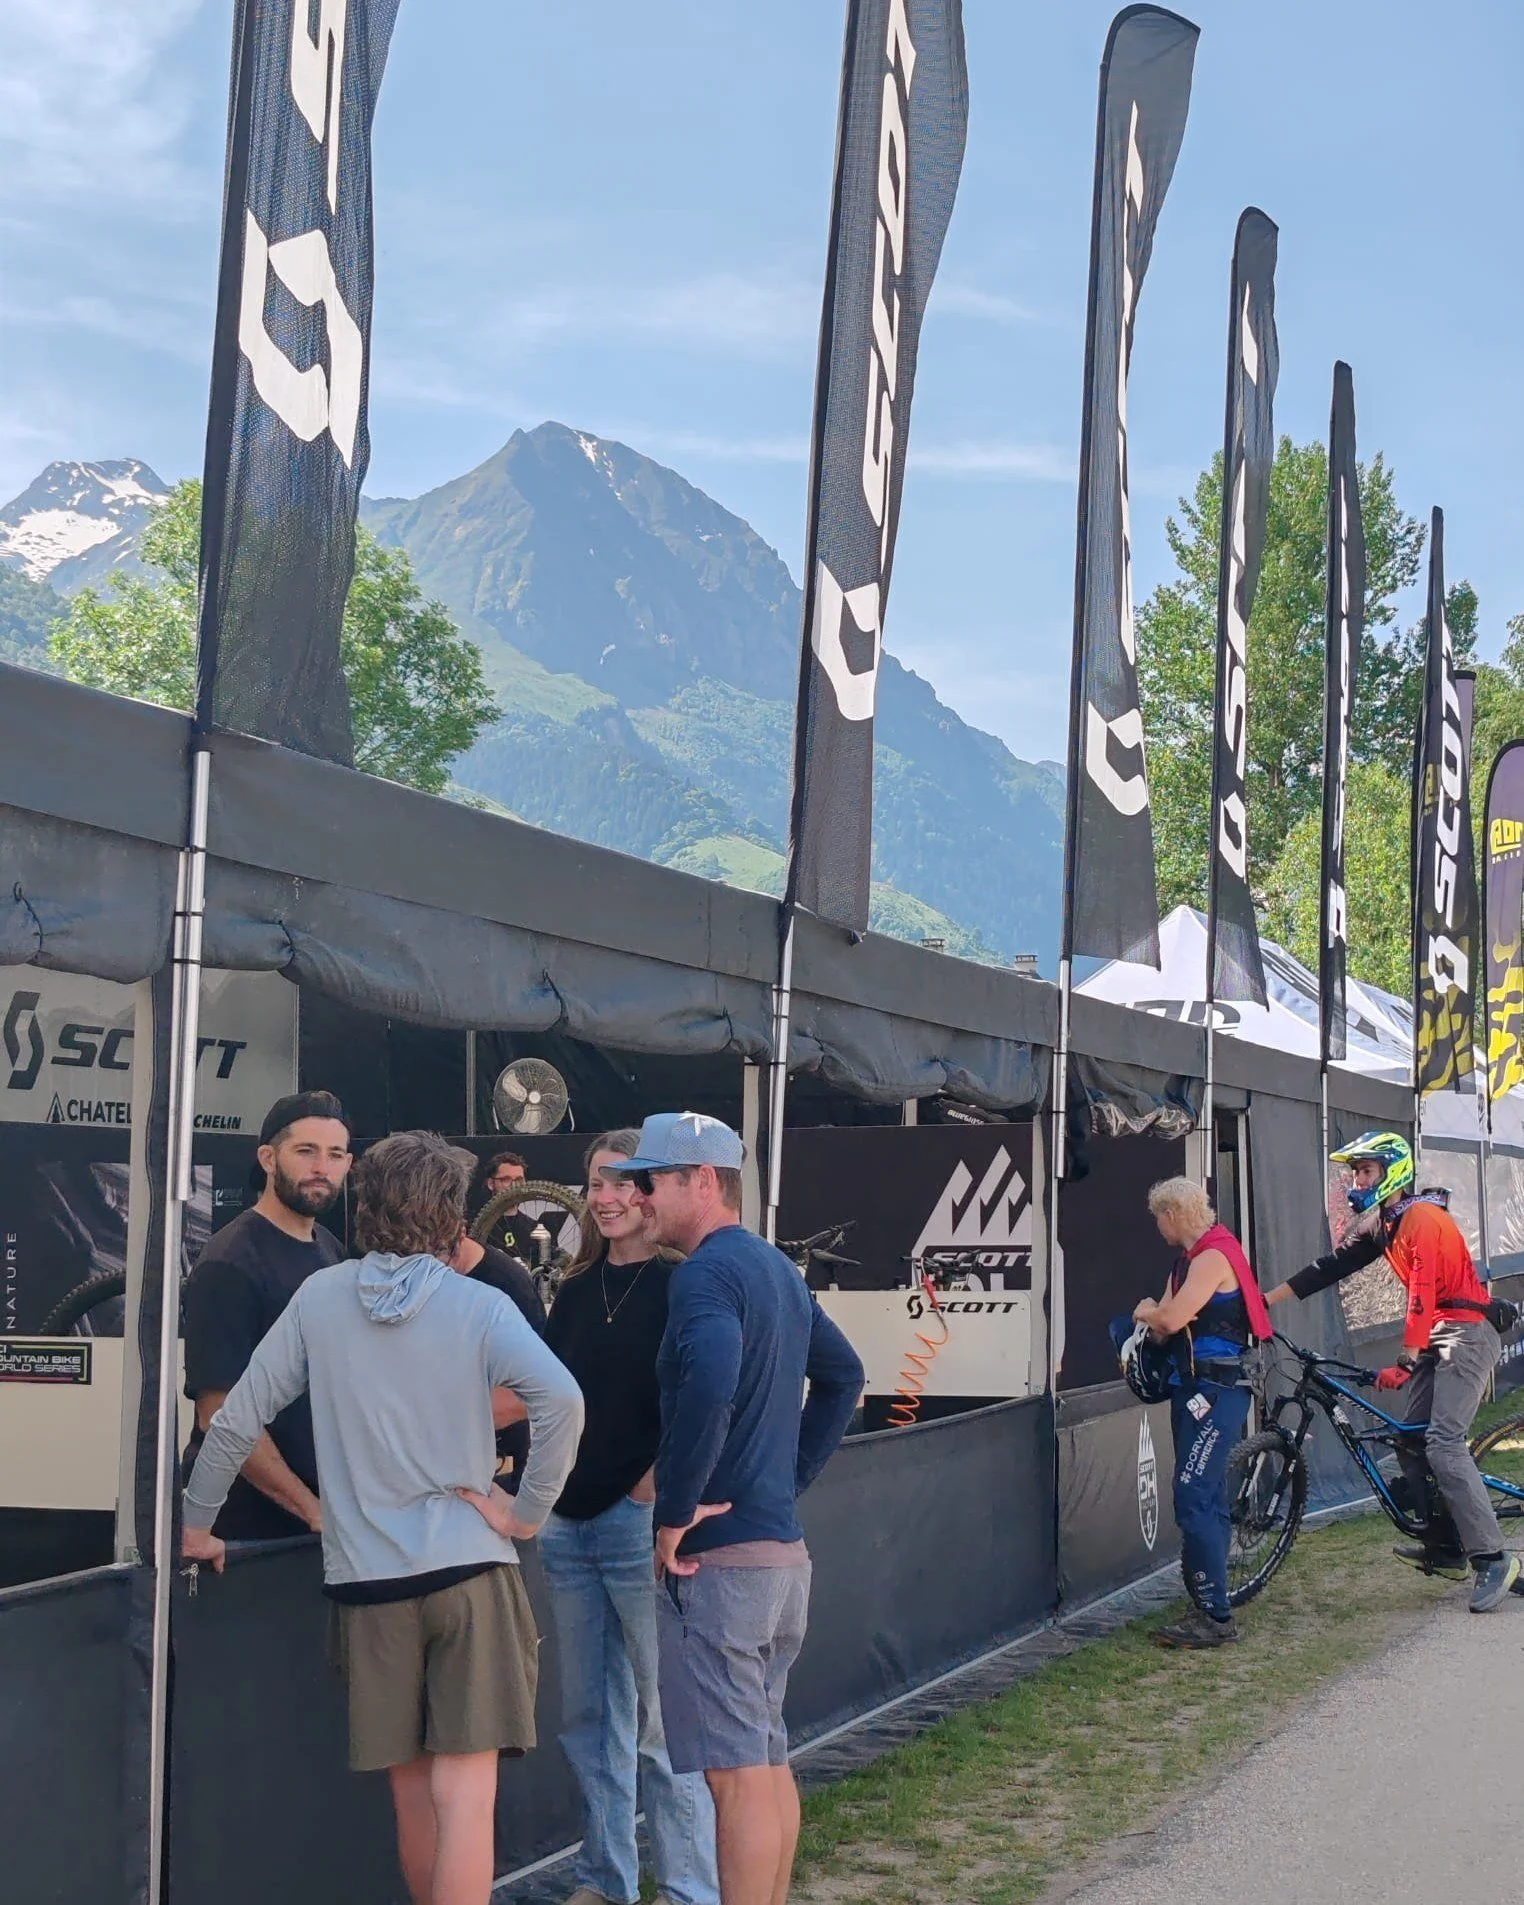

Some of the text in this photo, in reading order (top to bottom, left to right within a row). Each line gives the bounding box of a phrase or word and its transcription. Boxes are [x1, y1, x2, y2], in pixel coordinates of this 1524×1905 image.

[862, 0, 918, 577] SCOT
[51, 1023, 247, 1079] SCT
[193, 1114, 241, 1130] CHELIN
[6, 1232, 17, 1330] NATURE
[927, 1302, 1018, 1314] SCOTT
[0, 1354, 81, 1365] UNTAIN BIKE
[0, 1363, 81, 1374] RLD SERIES
[1185, 1423, 1214, 1472] DORVAL
